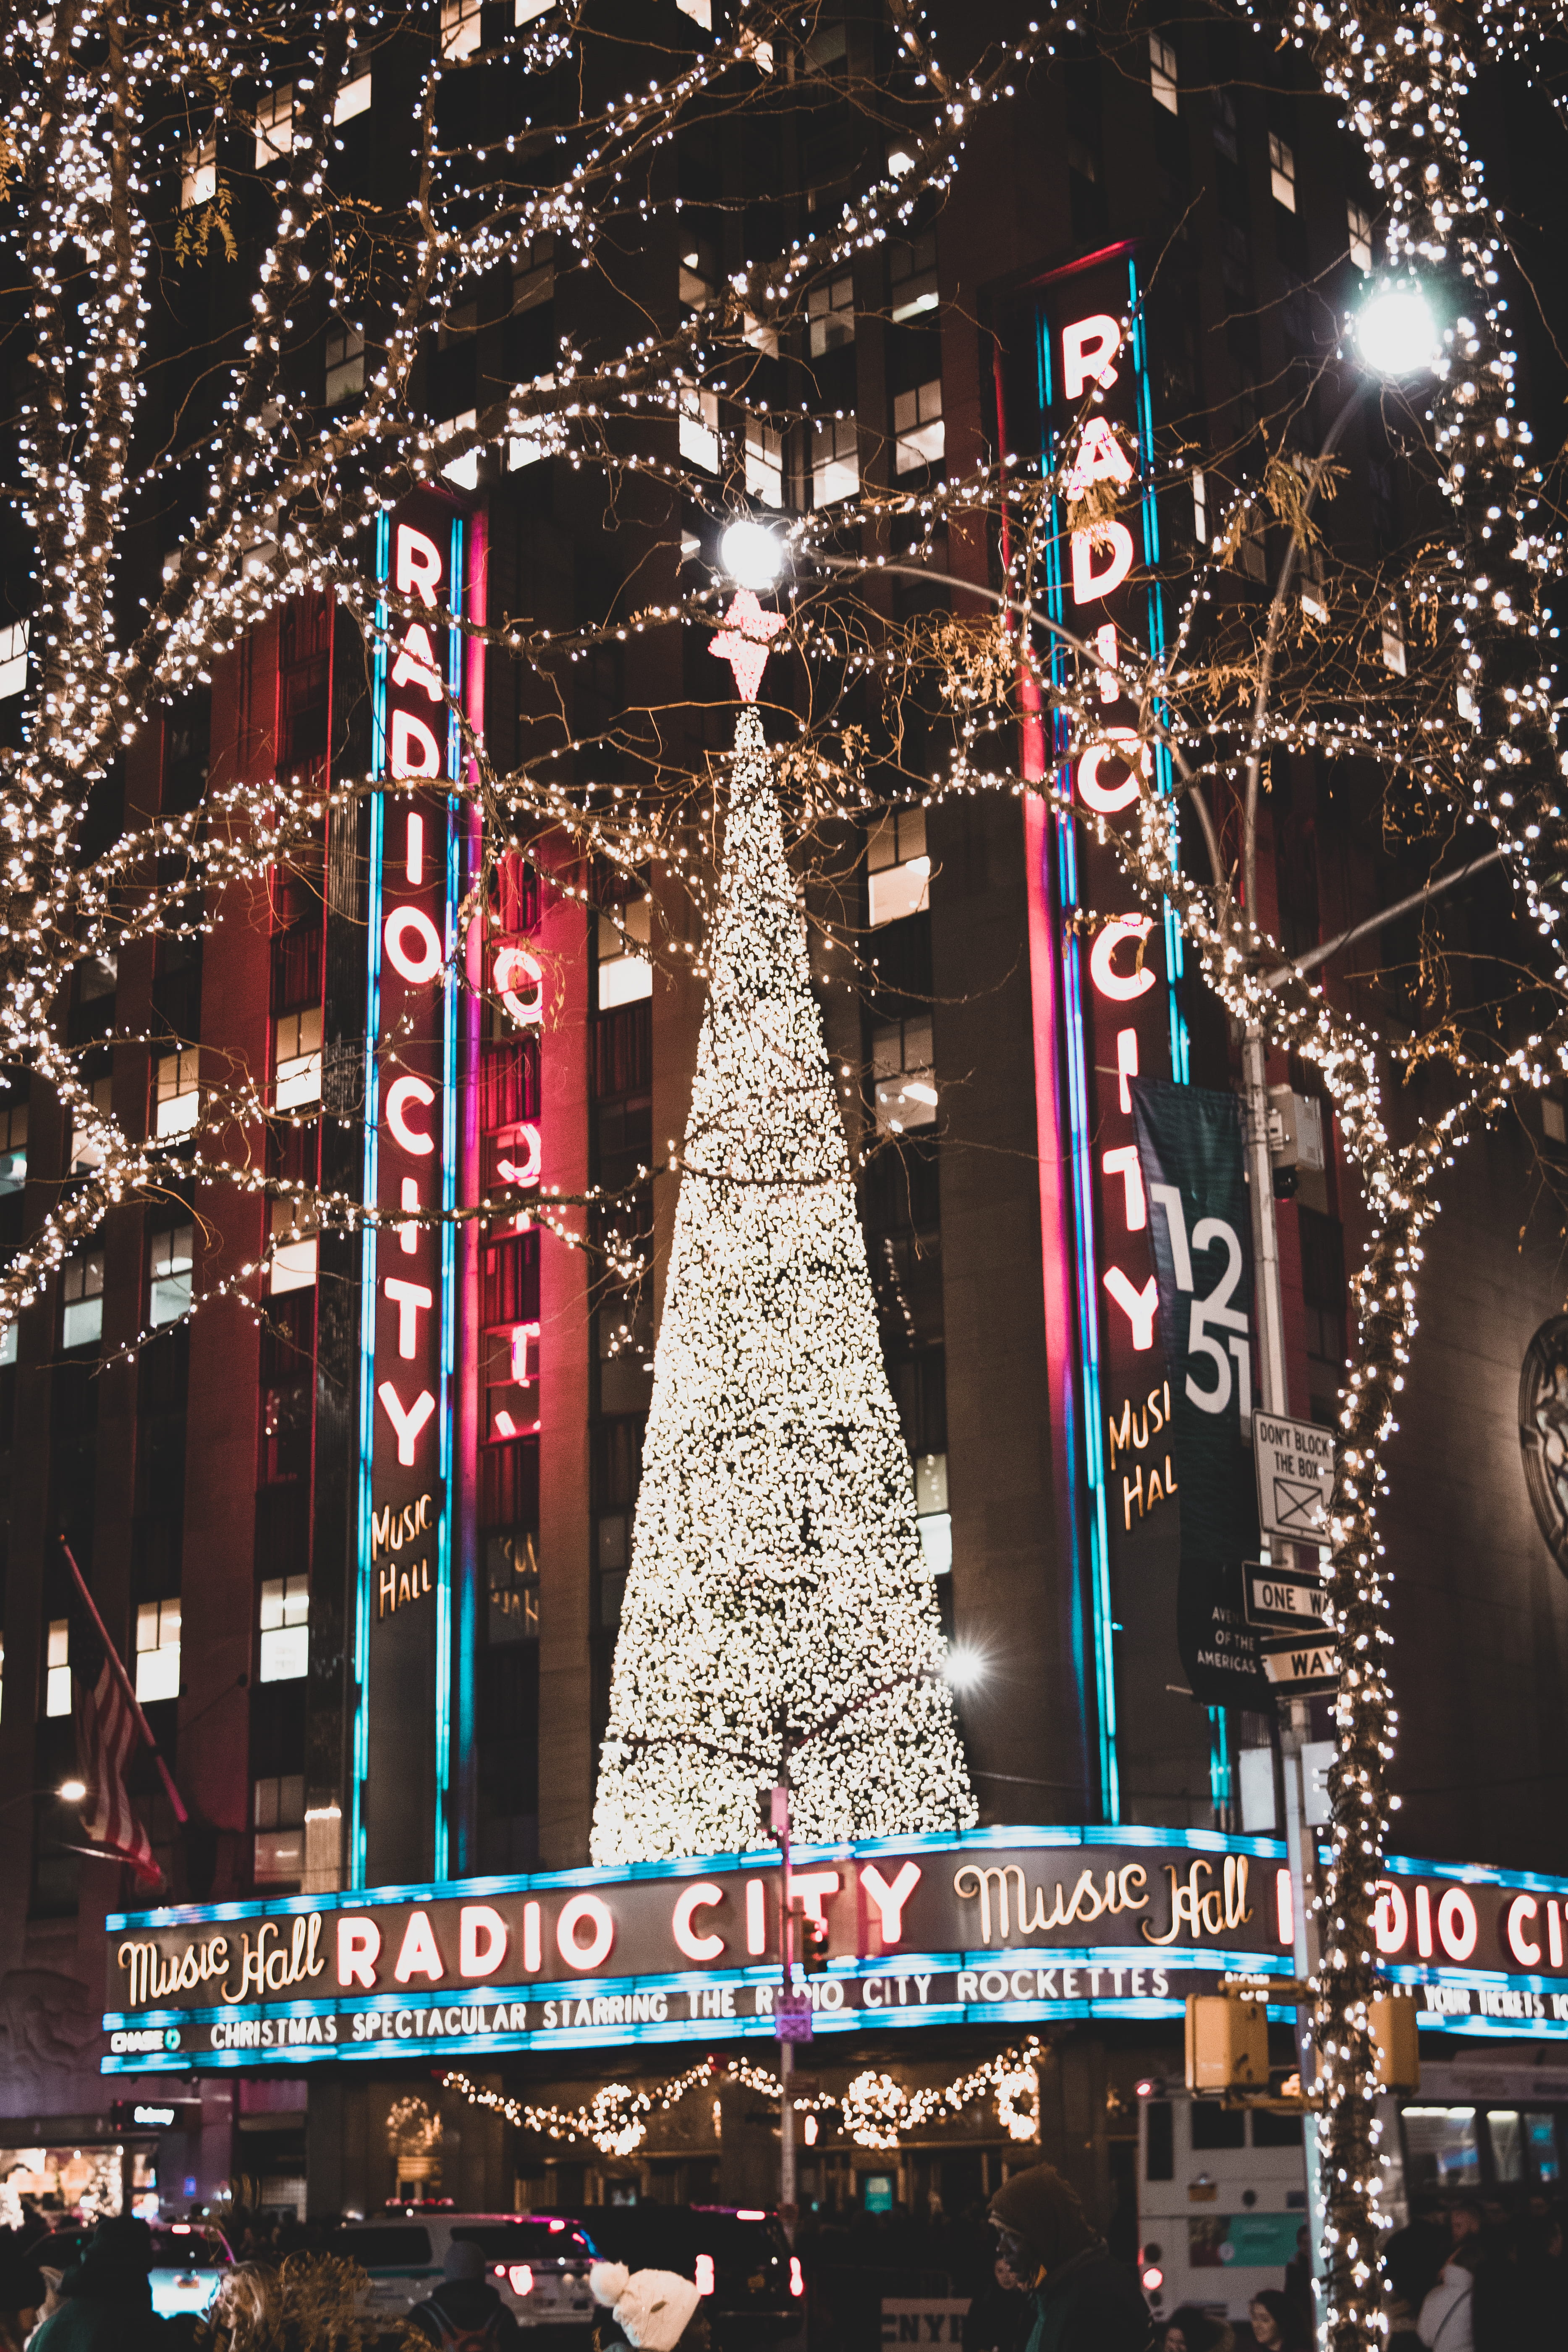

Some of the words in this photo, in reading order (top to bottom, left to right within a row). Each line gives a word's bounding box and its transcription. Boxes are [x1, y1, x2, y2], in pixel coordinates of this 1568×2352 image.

[1063, 314, 1152, 814] RADIO
[384, 523, 444, 983] RADIO
[1091, 912, 1159, 1351] CITY
[377, 1075, 435, 1467] CITY
[1109, 1380, 1170, 1470] MUSI
[1274, 1451, 1295, 1475] THE
[372, 1493, 432, 1561] MUSIC
[1123, 1454, 1178, 1530] HAL
[380, 1558, 432, 1617] HALL
[1262, 1584, 1296, 1611] ONE
[1197, 1649, 1257, 1674] AMERICAS
[1215, 1629, 1231, 1646] OF
[1234, 1633, 1254, 1652] THE
[338, 1893, 614, 1988] RADIO
[673, 1860, 921, 1961] CITY
[1508, 1894, 1568, 1967] CI
[210, 2015, 338, 2049] CHRISTMAS
[352, 2002, 526, 2042] SPECTACULAR
[542, 1993, 668, 2030] STARRING
[687, 1988, 736, 2017] THE
[862, 1975, 932, 2008] CITY
[957, 1968, 1170, 2002] ROCKETTES
